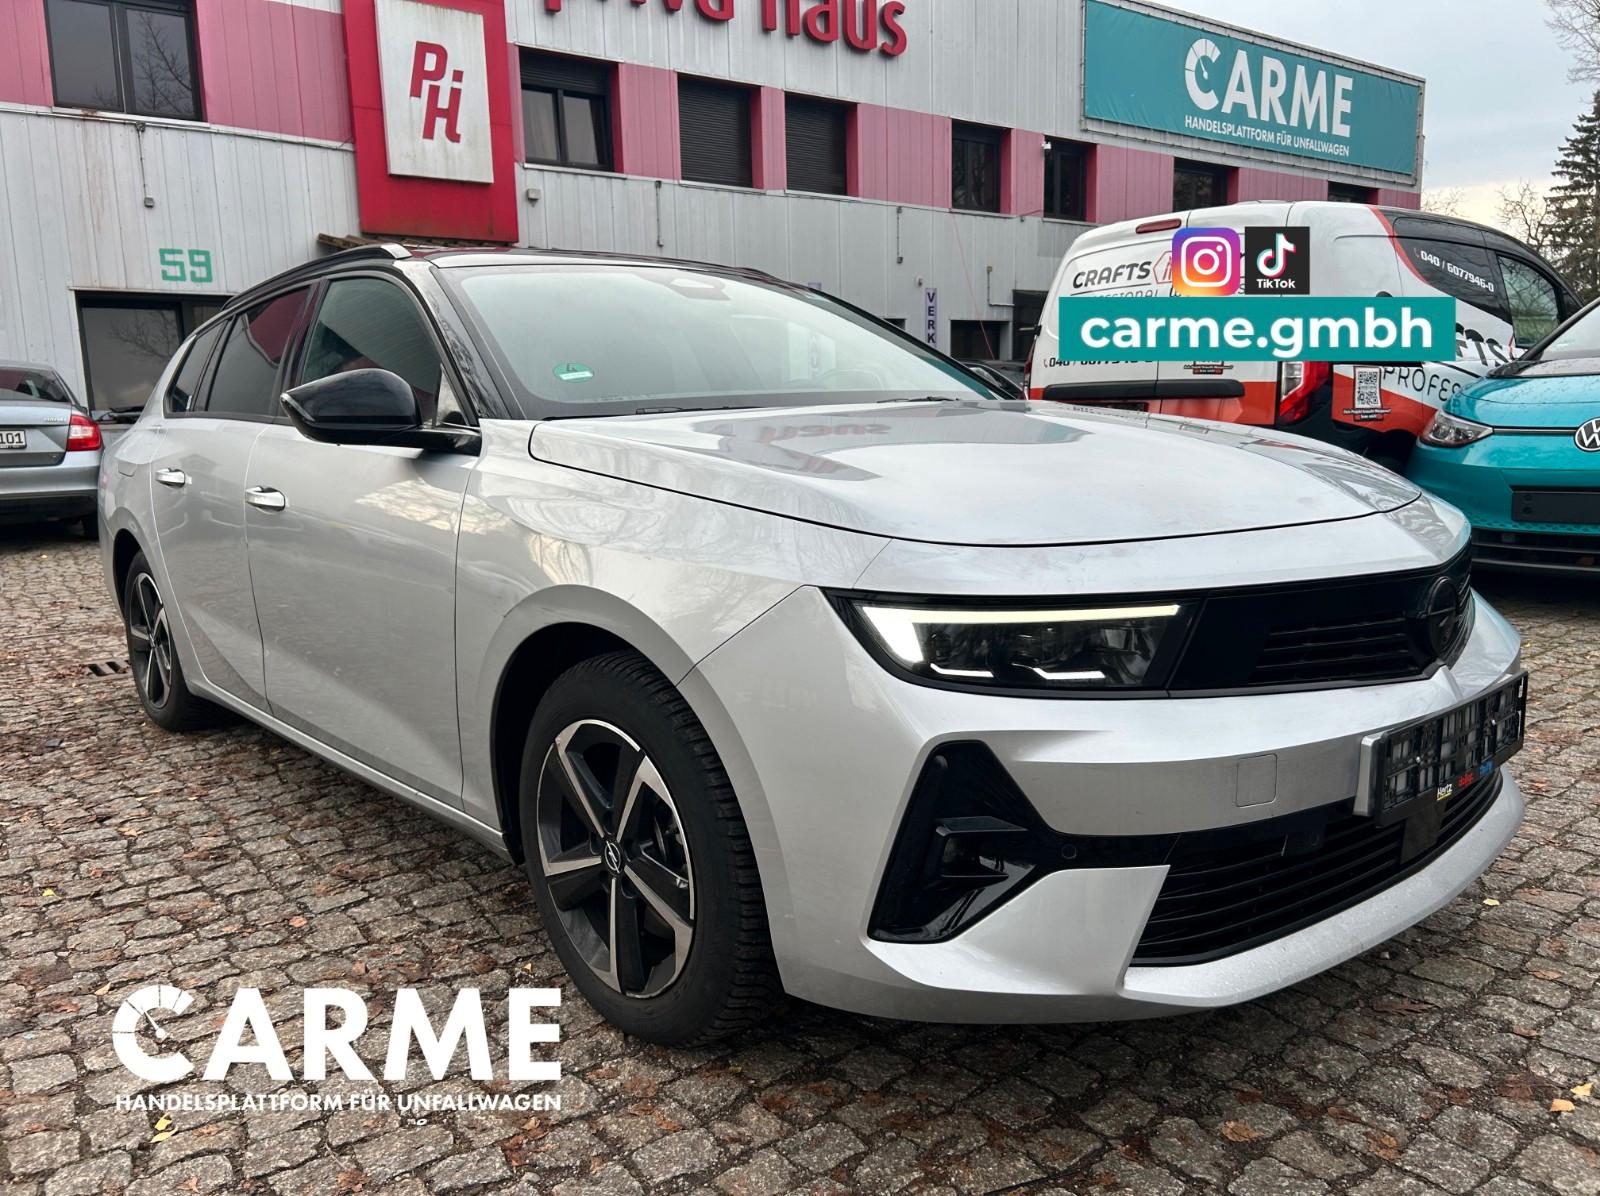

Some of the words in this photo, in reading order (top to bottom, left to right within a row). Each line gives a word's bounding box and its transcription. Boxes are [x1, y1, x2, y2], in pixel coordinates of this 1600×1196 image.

[1185, 38, 1353, 137] CARME
[1184, 114, 1275, 144] HANDELSPLATTFORM
[1276, 130, 1292, 147] FÜR
[1293, 135, 1350, 157] UNFALLWAGEN
[160, 248, 213, 283] 59
[1072, 260, 1152, 289] CRAFTS
[1420, 250, 1440, 267] 040
[1447, 262, 1495, 292] 6077946-0
[1437, 784, 1453, 799] Hertz
